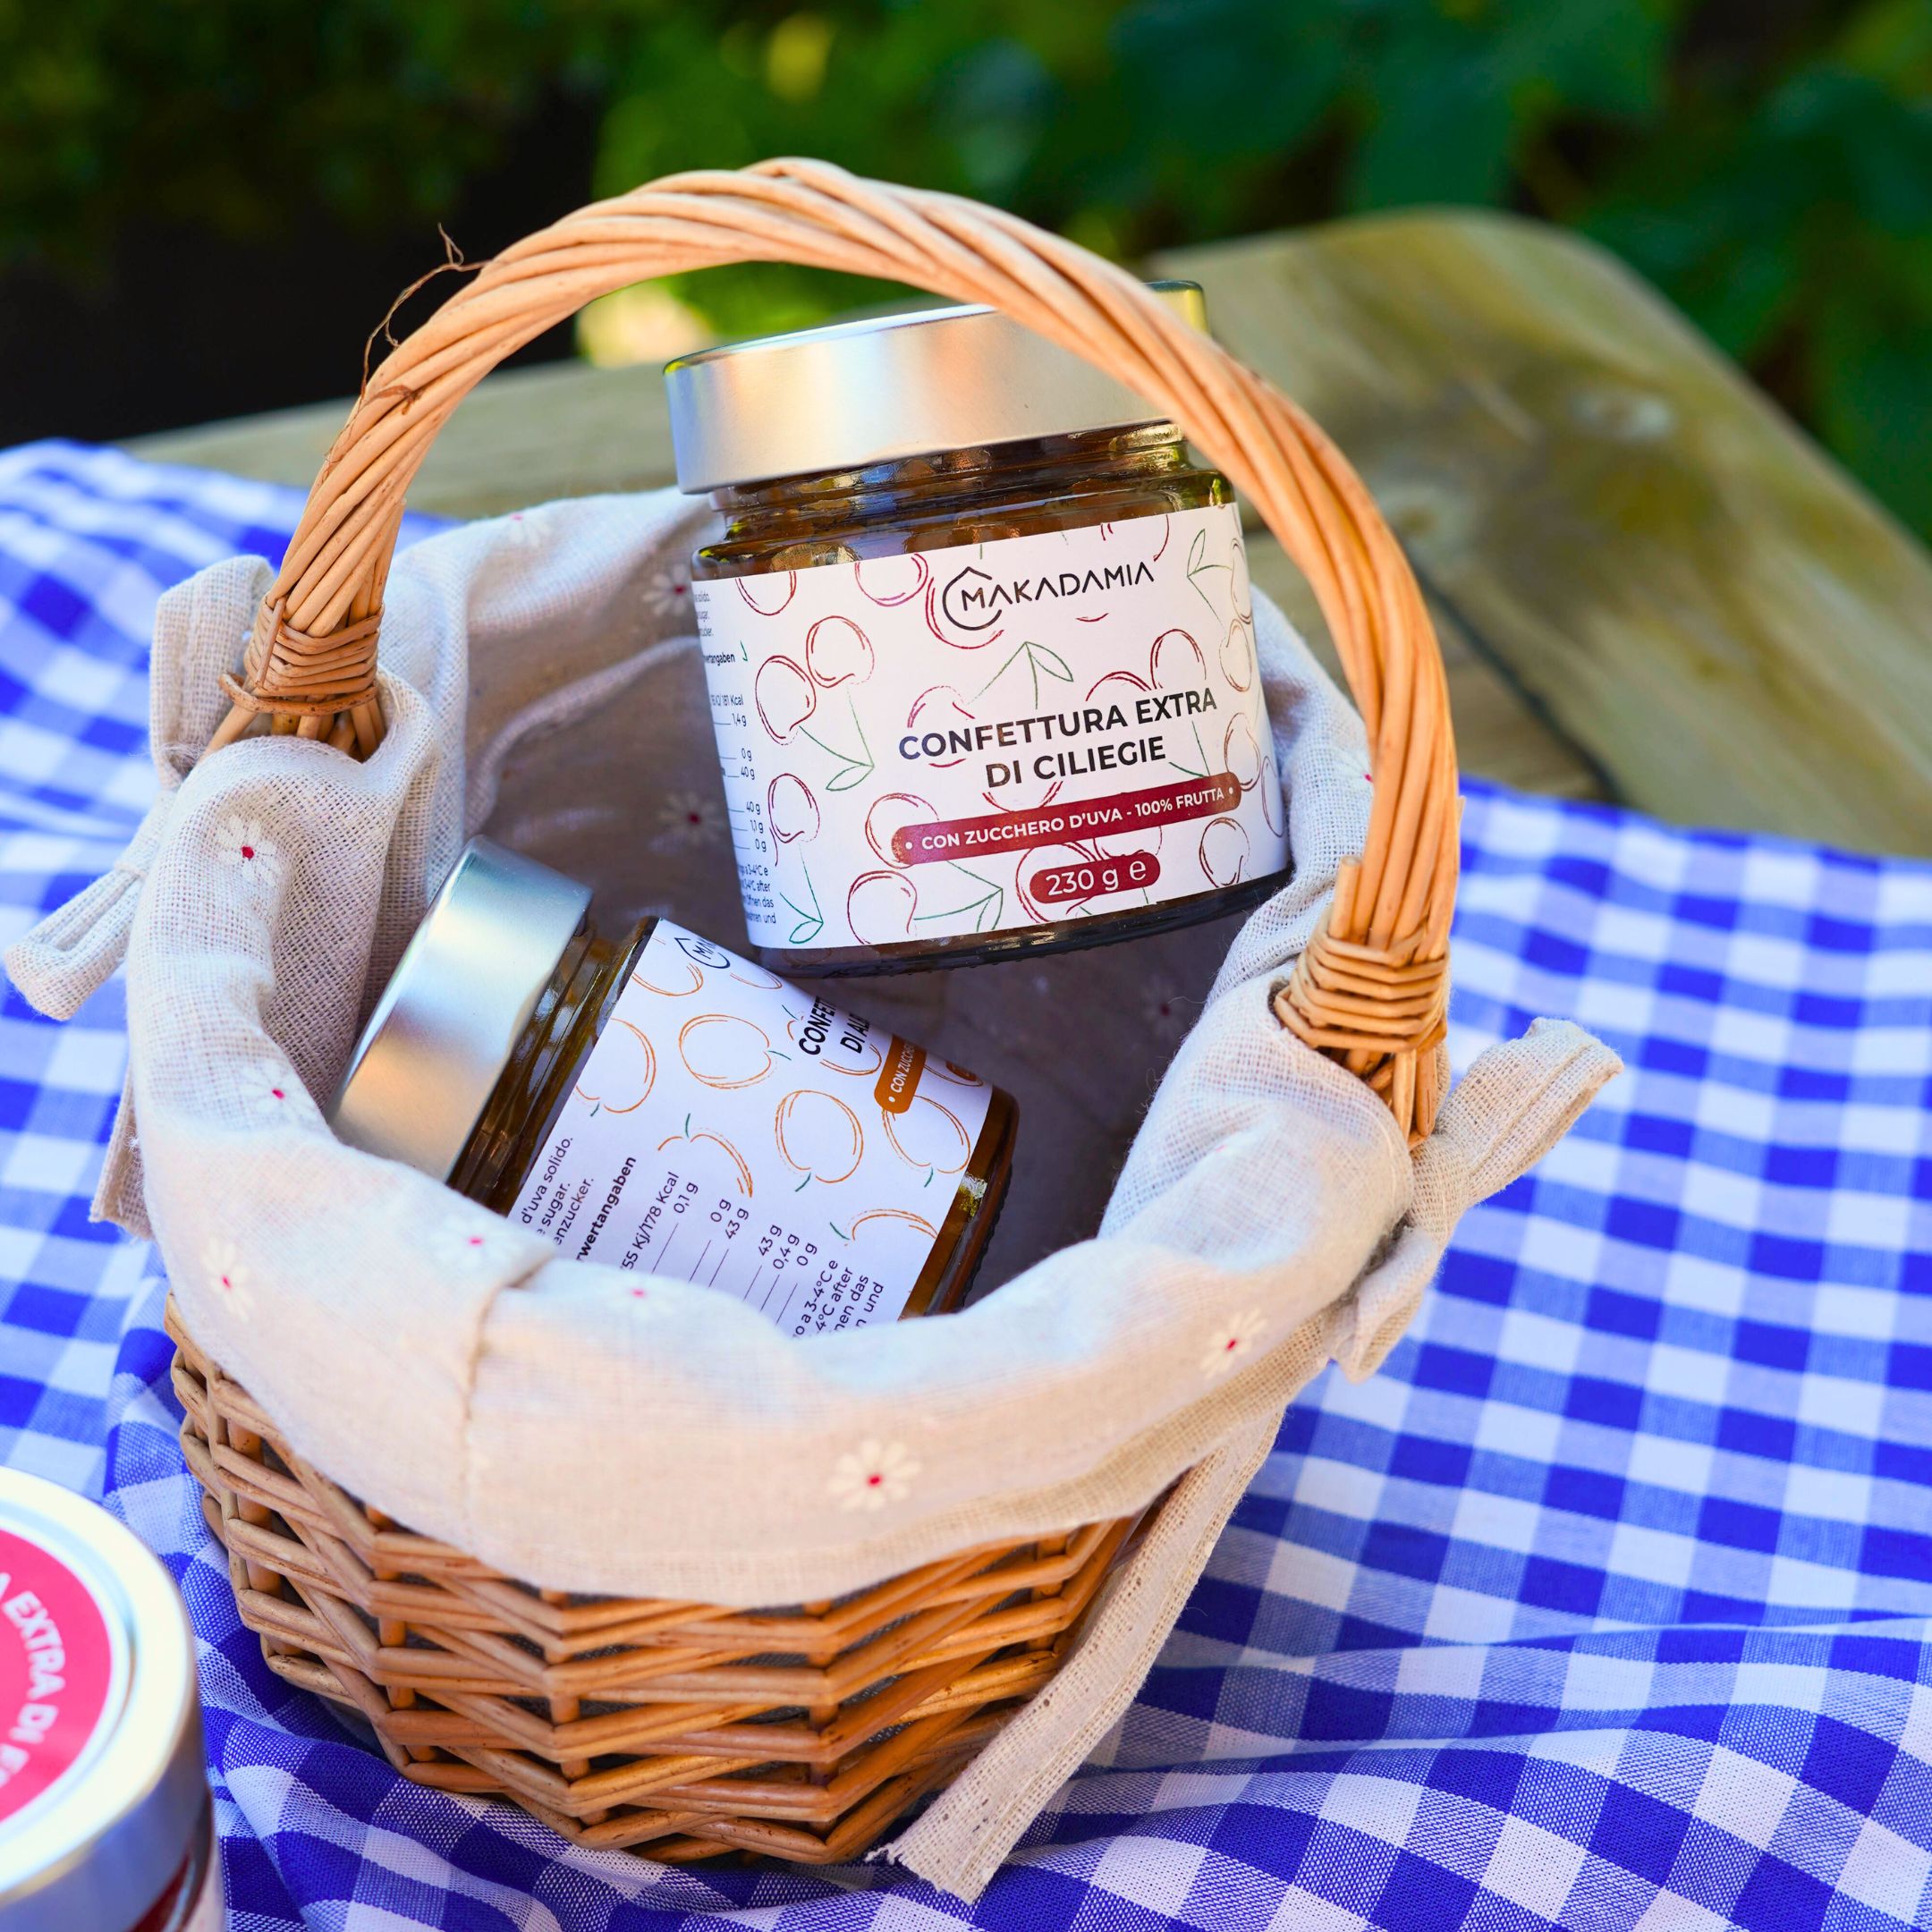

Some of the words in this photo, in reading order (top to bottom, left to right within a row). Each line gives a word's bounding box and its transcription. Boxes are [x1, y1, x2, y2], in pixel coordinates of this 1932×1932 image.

[962, 562, 1154, 611] MAKADAMIA
[731, 693, 744, 706] Kcal
[741, 716, 747, 726] g
[899, 705, 1128, 759] CONFETTURA
[1136, 688, 1217, 724] EXTRA
[741, 748, 747, 759] 0
[747, 750, 752, 761] g
[986, 760, 1021, 788] DI
[1033, 736, 1165, 780] CILIEGIE
[741, 767, 749, 777] 40
[750, 769, 755, 780] g
[746, 801, 755, 813] 40
[755, 804, 761, 815] g
[921, 833, 960, 850] CON
[964, 818, 1064, 844] ZUCCHERO
[1069, 809, 1123, 828] D'UVA
[1135, 798, 1173, 817] 100%
[1175, 787, 1224, 809] FRUTTA
[758, 823, 764, 834] g
[755, 838, 760, 850] 0
[761, 841, 767, 852] g
[757, 879, 770, 892] after
[1046, 869, 1095, 896] 230
[1102, 868, 1119, 891] g
[762, 895, 774, 908] das
[764, 912, 776, 923] und
[840, 1030, 865, 1054] DI
[890, 1070, 907, 1093] CON
[521, 1184, 547, 1224] d'uva
[543, 1137, 573, 1183] solido.
[541, 1182, 571, 1227] sugar.
[553, 1178, 594, 1246] enzucker.
[576, 1157, 637, 1261] rwertangaben
[674, 1195, 691, 1214] 0,1
[686, 1182, 699, 1194] g
[710, 1211, 723, 1223] 0
[719, 1199, 732, 1211] g
[620, 1250, 639, 1270] 55
[631, 1206, 662, 1250] Kj/178
[656, 1171, 680, 1204] Kcal
[724, 1219, 741, 1240] 43
[736, 1208, 749, 1220] g
[758, 1236, 774, 1257] 43
[769, 1224, 782, 1237] g
[773, 1246, 792, 1270] 0,4
[787, 1233, 800, 1246] g
[796, 1255, 809, 1267] 0
[805, 1242, 818, 1255] g
[828, 1260, 838, 1269] e
[804, 1270, 833, 1312] 3-4°C
[816, 1303, 835, 1331] 4°C
[831, 1267, 853, 1302] after
[834, 1305, 854, 1332] nen
[851, 1275, 869, 1301] das
[863, 1282, 884, 1312] und
[801, 1314, 811, 1324] a
[3, 1589, 65, 1701] EXTRA
[9, 1702, 59, 1745] DI
